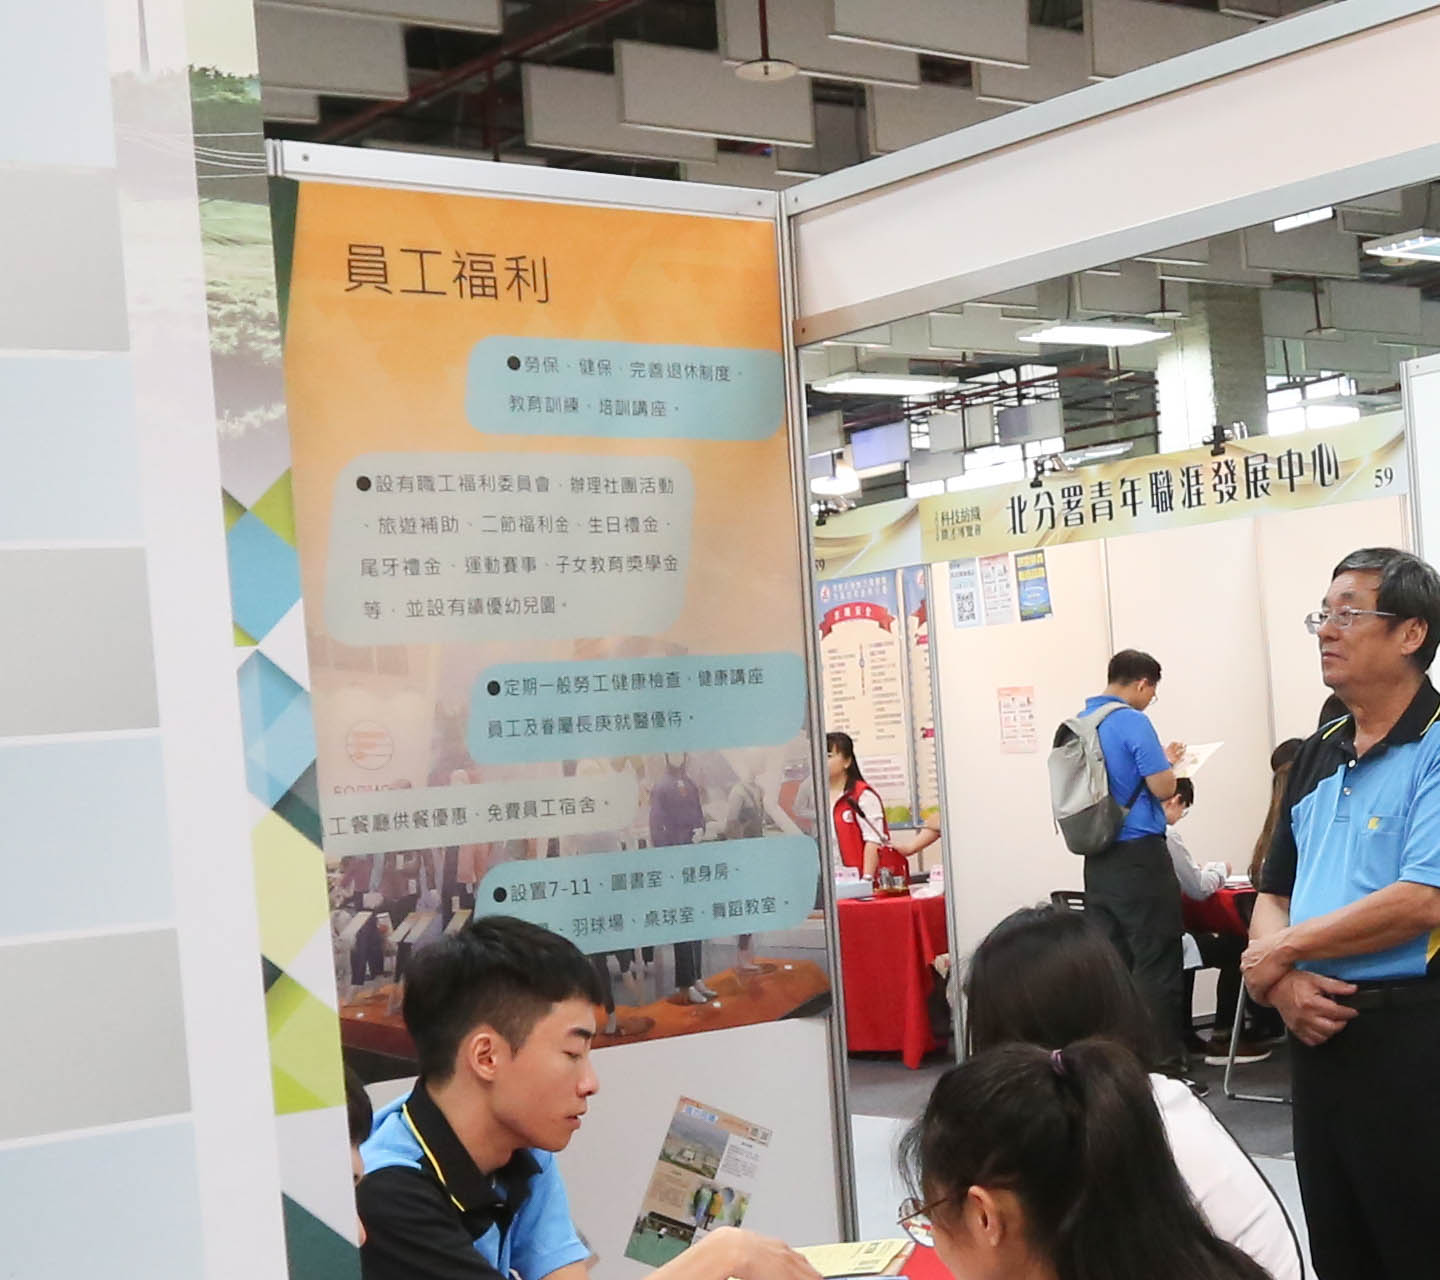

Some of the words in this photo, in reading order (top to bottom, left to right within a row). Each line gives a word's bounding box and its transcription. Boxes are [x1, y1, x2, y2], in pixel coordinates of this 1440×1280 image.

[344, 243, 551, 305] 員工福利
[1006, 441, 1340, 535] 北分署青年職涯發展中心
[1373, 467, 1395, 489] 59
